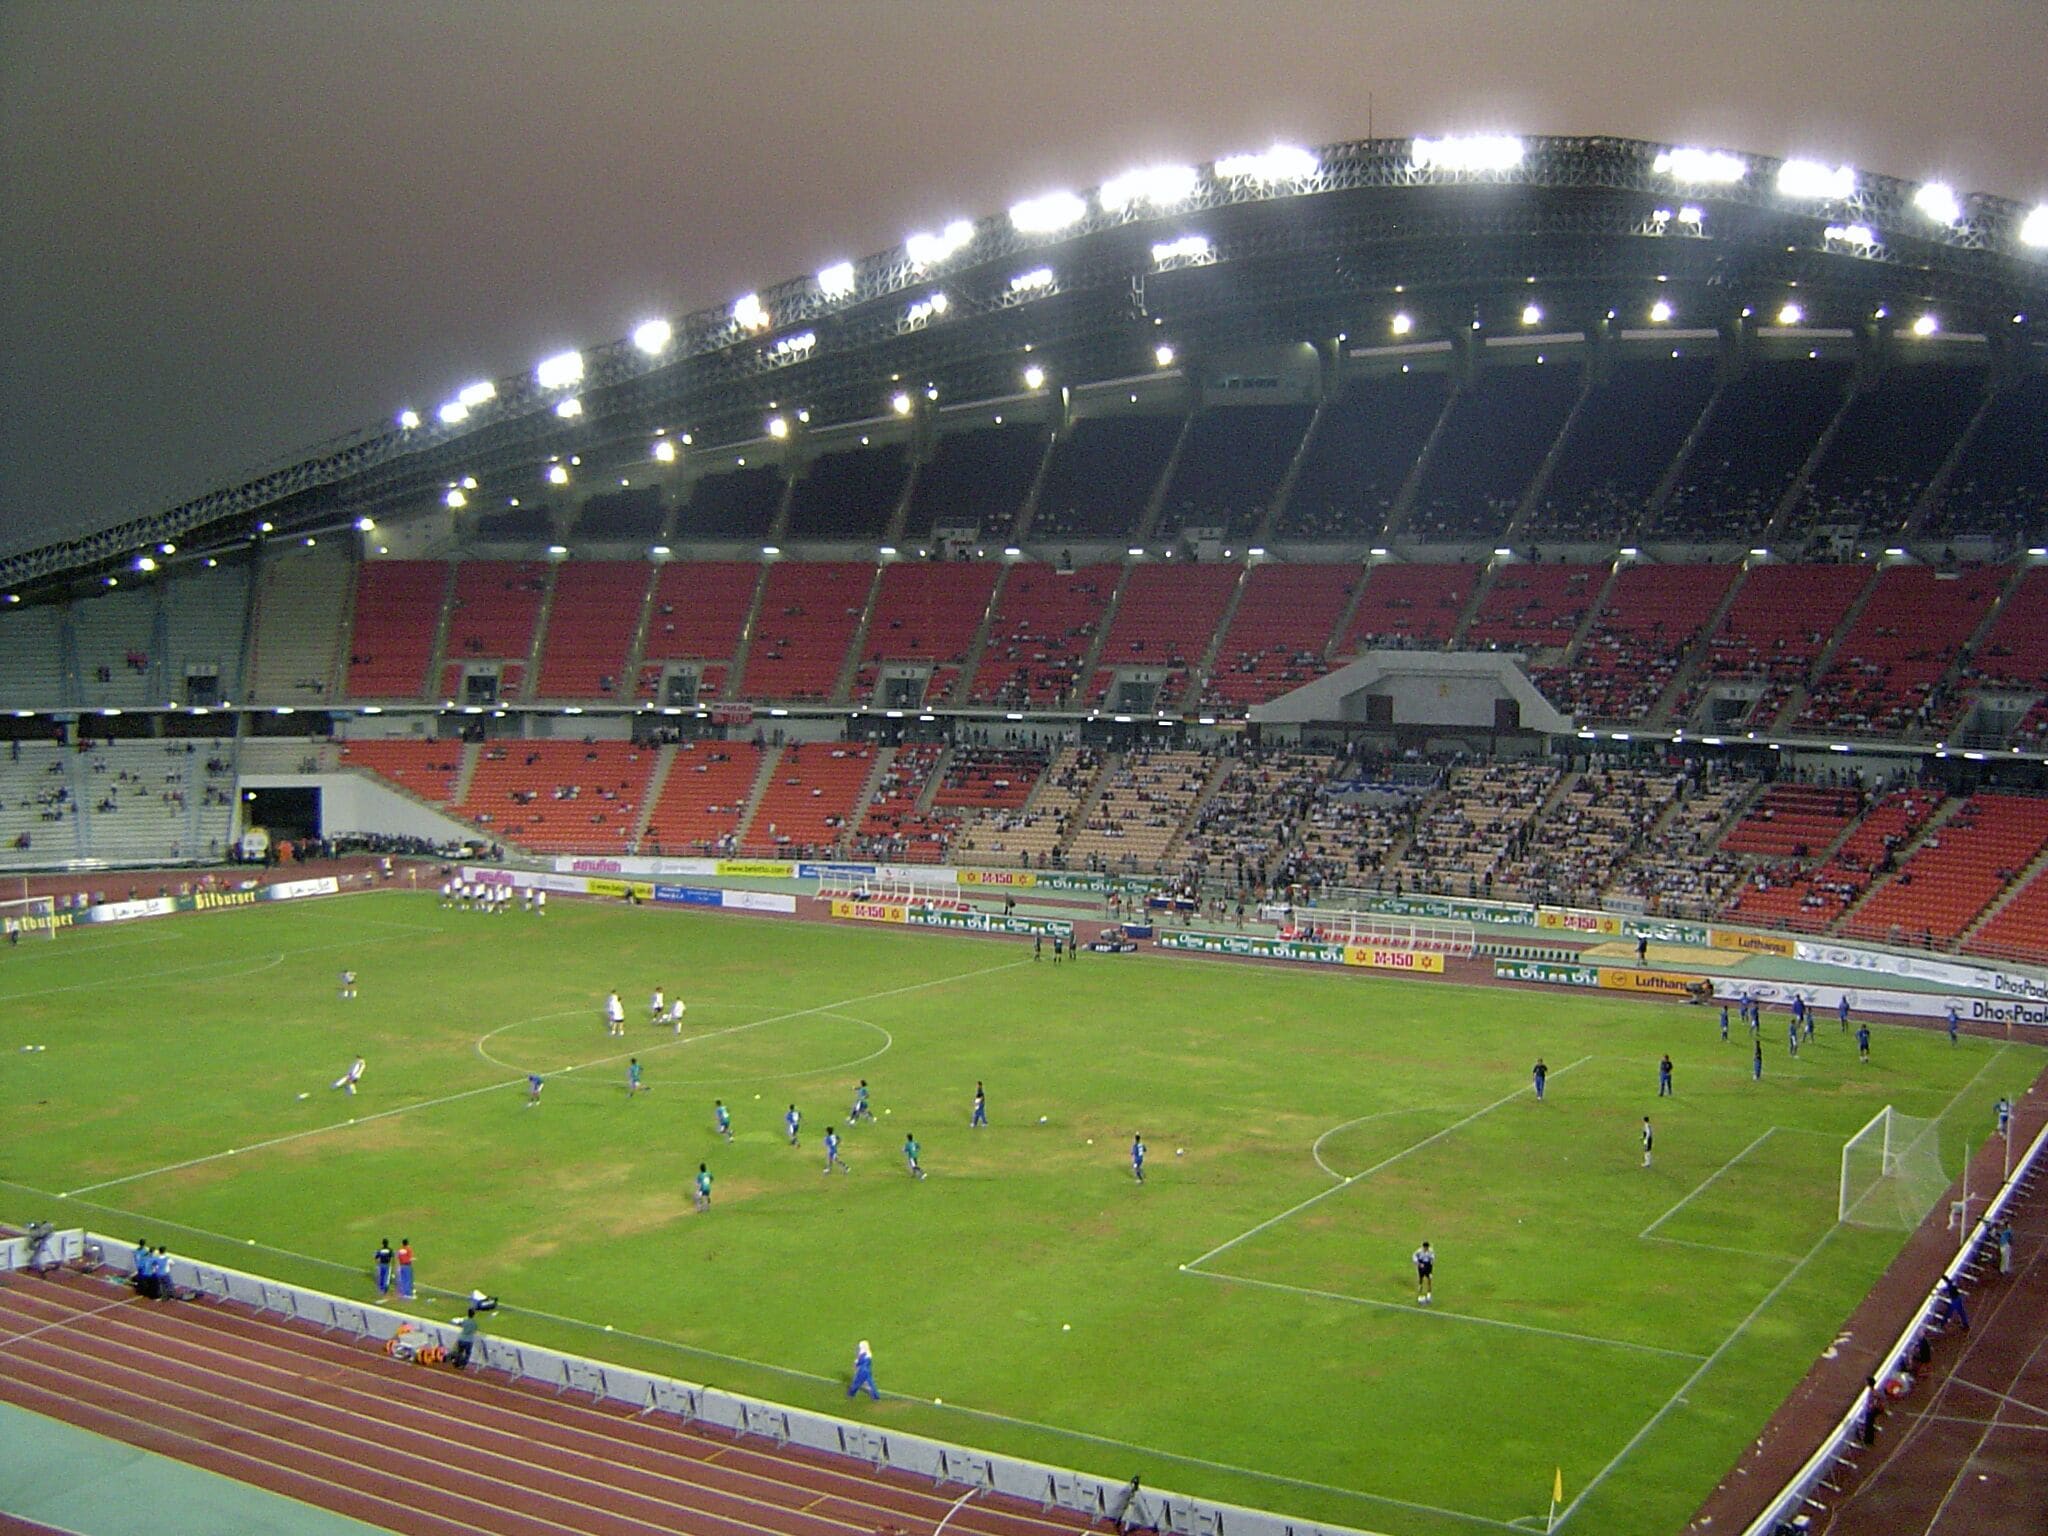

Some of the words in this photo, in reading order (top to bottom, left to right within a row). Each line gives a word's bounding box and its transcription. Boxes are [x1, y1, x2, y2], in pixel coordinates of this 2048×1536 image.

[982, 872, 1013, 884] M-150
[195, 891, 255, 909] Bitburger
[855, 905, 886, 918] M-150
[1738, 937, 1787, 953] Lufthansa
[1374, 951, 1414, 967] M-150
